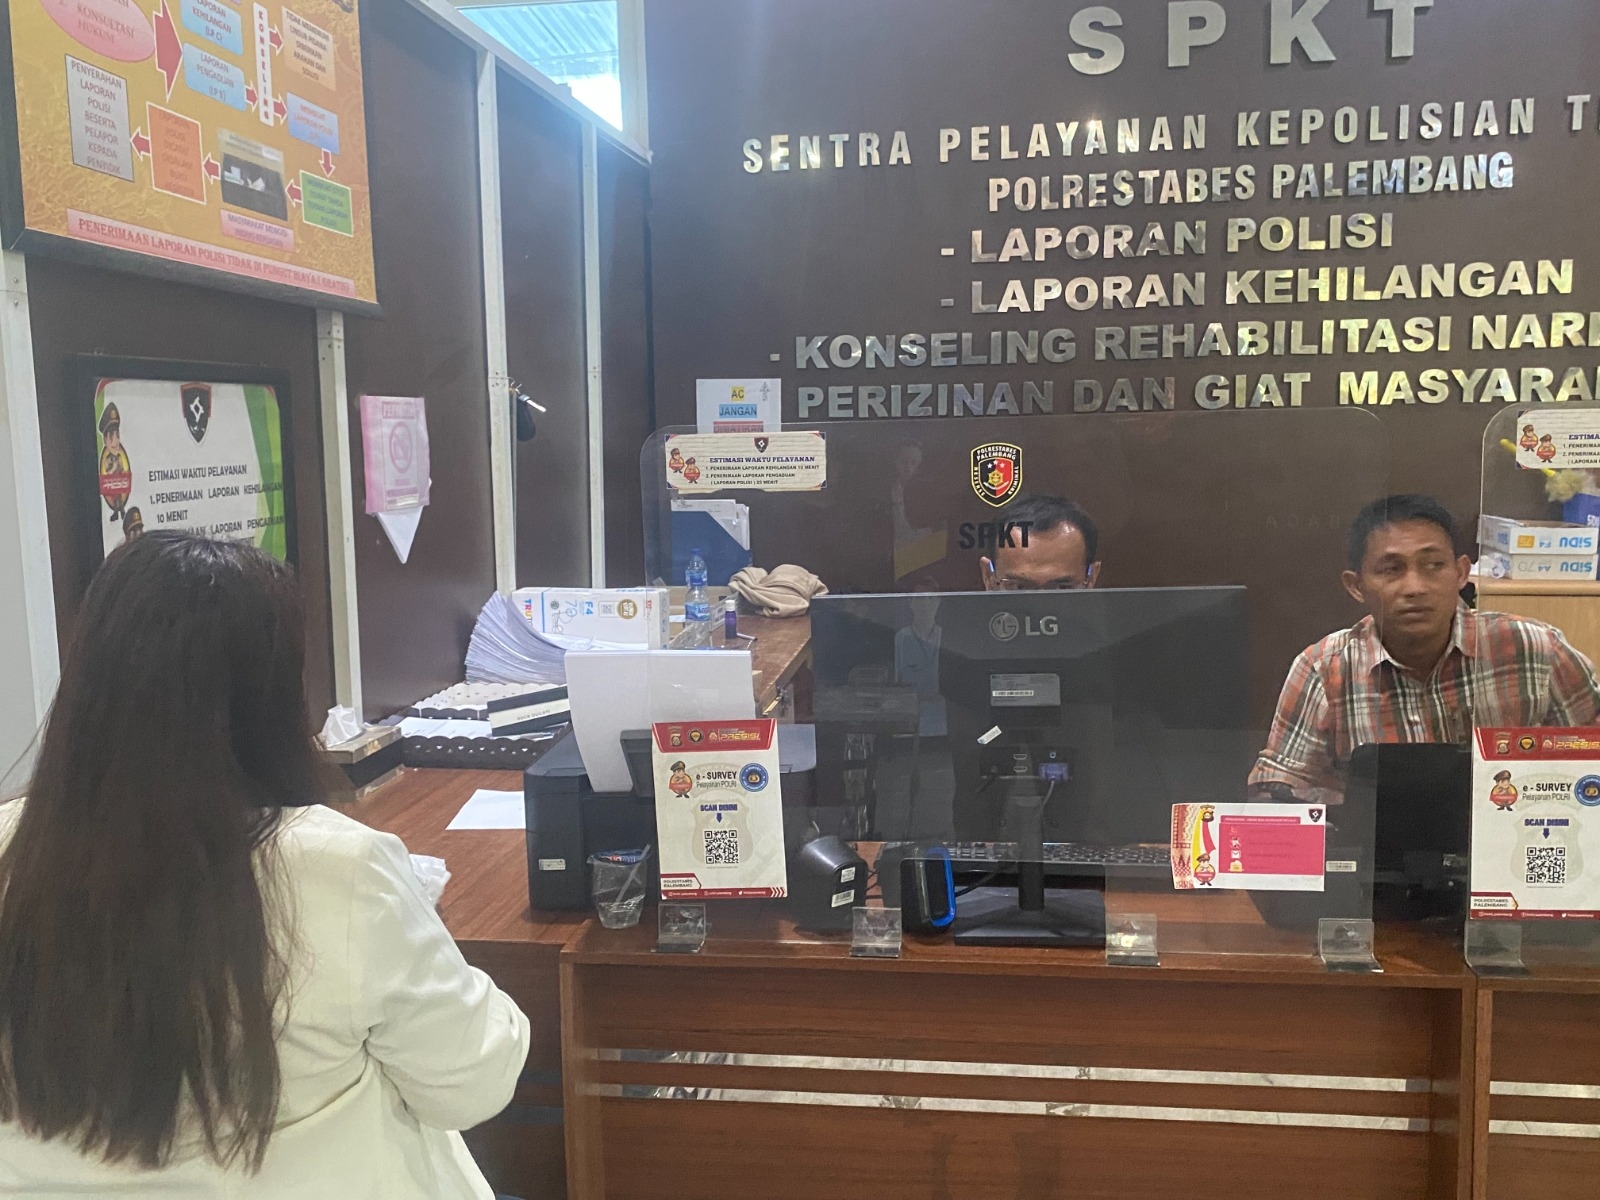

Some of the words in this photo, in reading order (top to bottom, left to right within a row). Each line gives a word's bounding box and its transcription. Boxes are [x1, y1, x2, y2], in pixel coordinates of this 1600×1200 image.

[77, 4, 134, 39] KONSULTASI
[200, 53, 229, 73] LAPORAN
[71, 60, 122, 89] PENYERAHAN
[196, 64, 235, 88] PENGADUAN
[80, 79, 116, 101] LAPORAN
[87, 97, 112, 114] POLISI
[84, 110, 117, 131] BESERTA
[84, 126, 119, 145] PELAPOR
[742, 130, 912, 173] SENTRA
[939, 114, 1206, 163] PELAYANAN
[1237, 98, 1535, 147] KEPOLISIAN
[1567, 94, 1600, 131] T
[88, 142, 118, 159] KEPADA
[988, 164, 1256, 212] POLRESTABES
[1272, 151, 1514, 200] PALEMBANG
[78, 218, 150, 246] PENERIMAAN
[151, 237, 197, 257] LAPORAN
[198, 247, 226, 265] POLISI
[228, 254, 253, 271] TIDAK
[971, 220, 1206, 263] LAPORAN
[1227, 212, 1394, 253] POLISI
[971, 272, 1206, 314] LAPORAN
[1225, 259, 1574, 306] KEHILANGAN
[795, 328, 1077, 369] KONSELING
[1095, 316, 1452, 361] REHABILITASI
[731, 389, 745, 399] AC
[797, 380, 1054, 419] PERIZINAN
[1074, 377, 1175, 412] DAN
[1194, 372, 1311, 410] GIAT
[1339, 366, 1600, 406] MASYARA
[719, 405, 758, 417] JANGAN
[976, 451, 1017, 461] PALEMBANG
[149, 468, 180, 482] ESTIMASI
[181, 466, 207, 479] WAKTU
[207, 464, 248, 477] PELAYANAN
[149, 495, 156, 504] 1.
[156, 489, 203, 504] PENERIMAAN
[208, 486, 240, 498] LAPORAN
[156, 513, 164, 523] 10
[166, 510, 188, 522] MENIT
[210, 518, 243, 535] LAPORAN
[958, 520, 1034, 549] SPKT
[1559, 536, 1592, 548] SiDU
[1560, 561, 1592, 573] SiDU
[585, 601, 594, 615] F4
[1025, 616, 1059, 636] LG
[706, 771, 737, 780] SURVEY
[721, 780, 737, 788] POLRI
[1536, 783, 1572, 791] SURVEY
[1522, 793, 1551, 802] Pelayanan
[1552, 792, 1570, 800] POLRI
